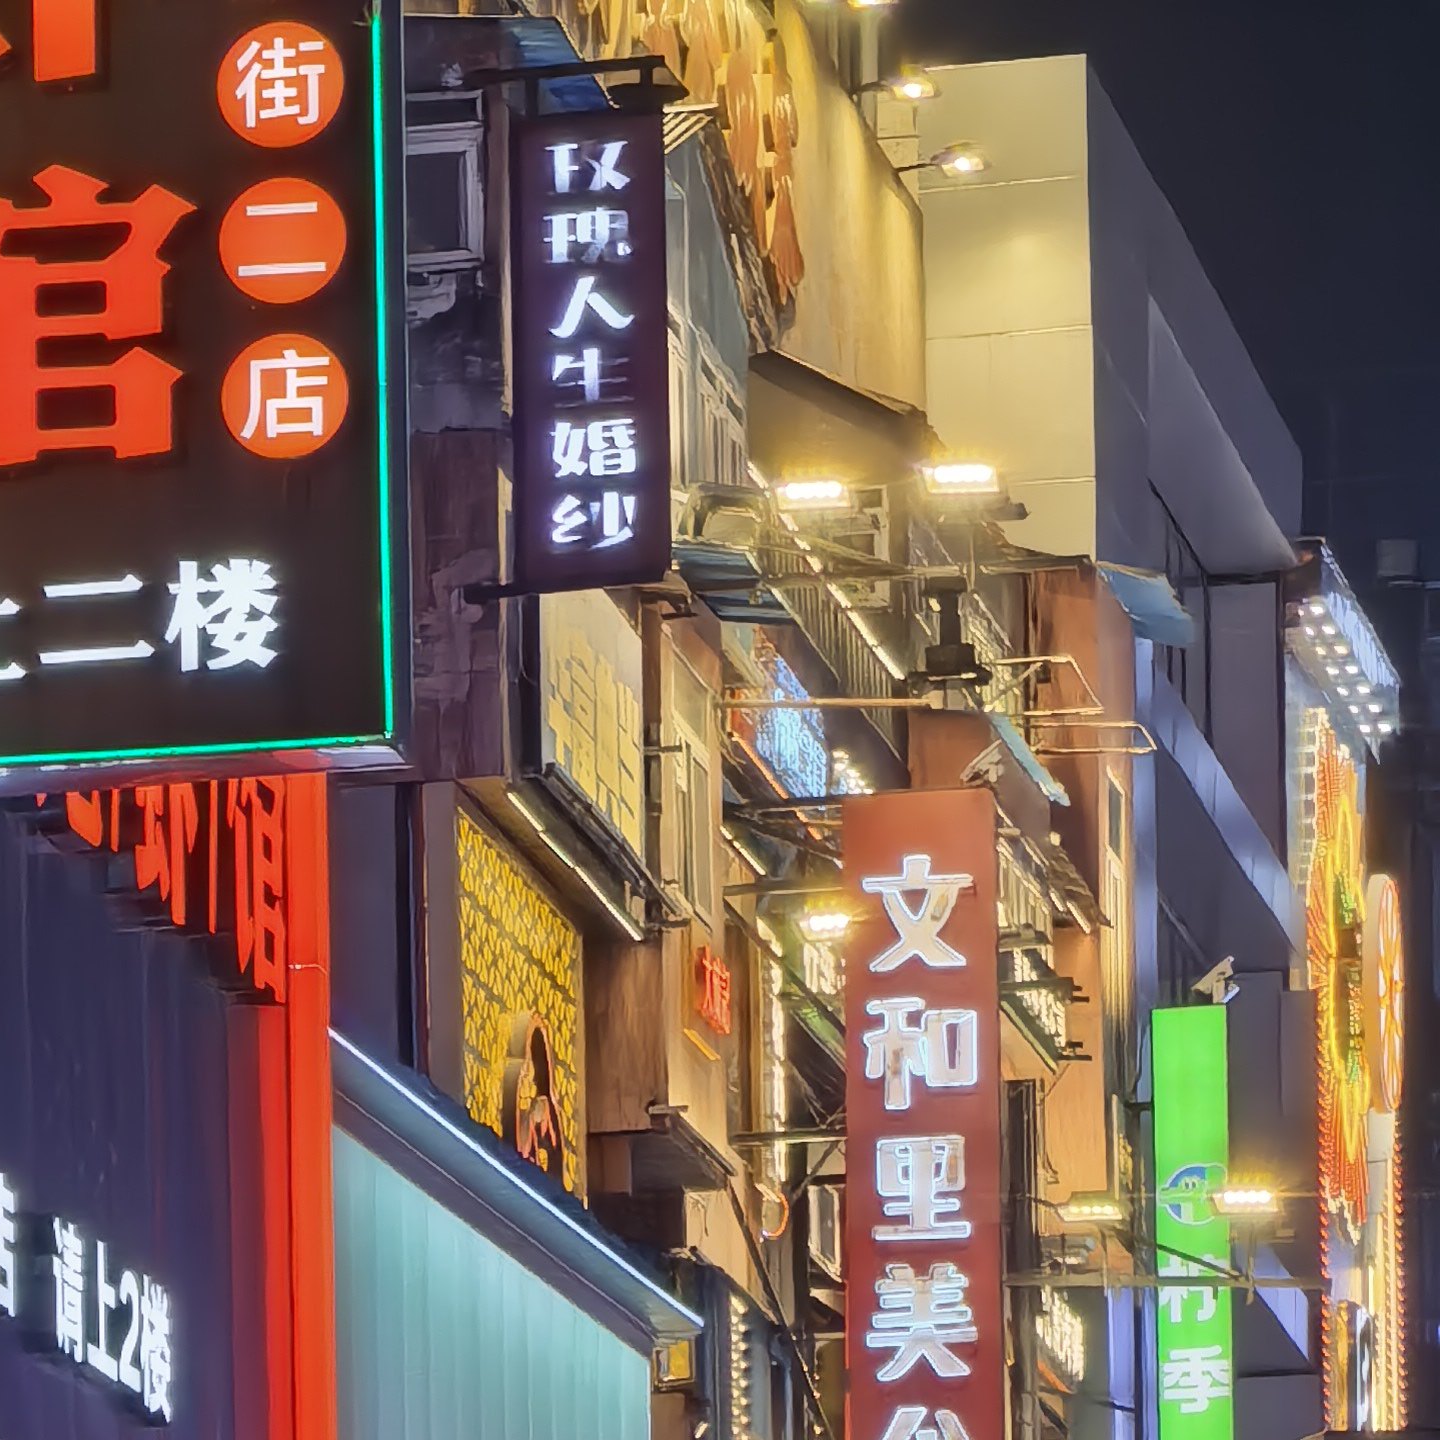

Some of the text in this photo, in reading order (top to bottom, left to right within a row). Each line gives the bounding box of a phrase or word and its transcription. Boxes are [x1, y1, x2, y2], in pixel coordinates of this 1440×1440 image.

[234, 37, 330, 440] 街二店
[542, 140, 638, 550] 玫瑰人生婚纱
[52, 1215, 173, 1422] 请上2楼
